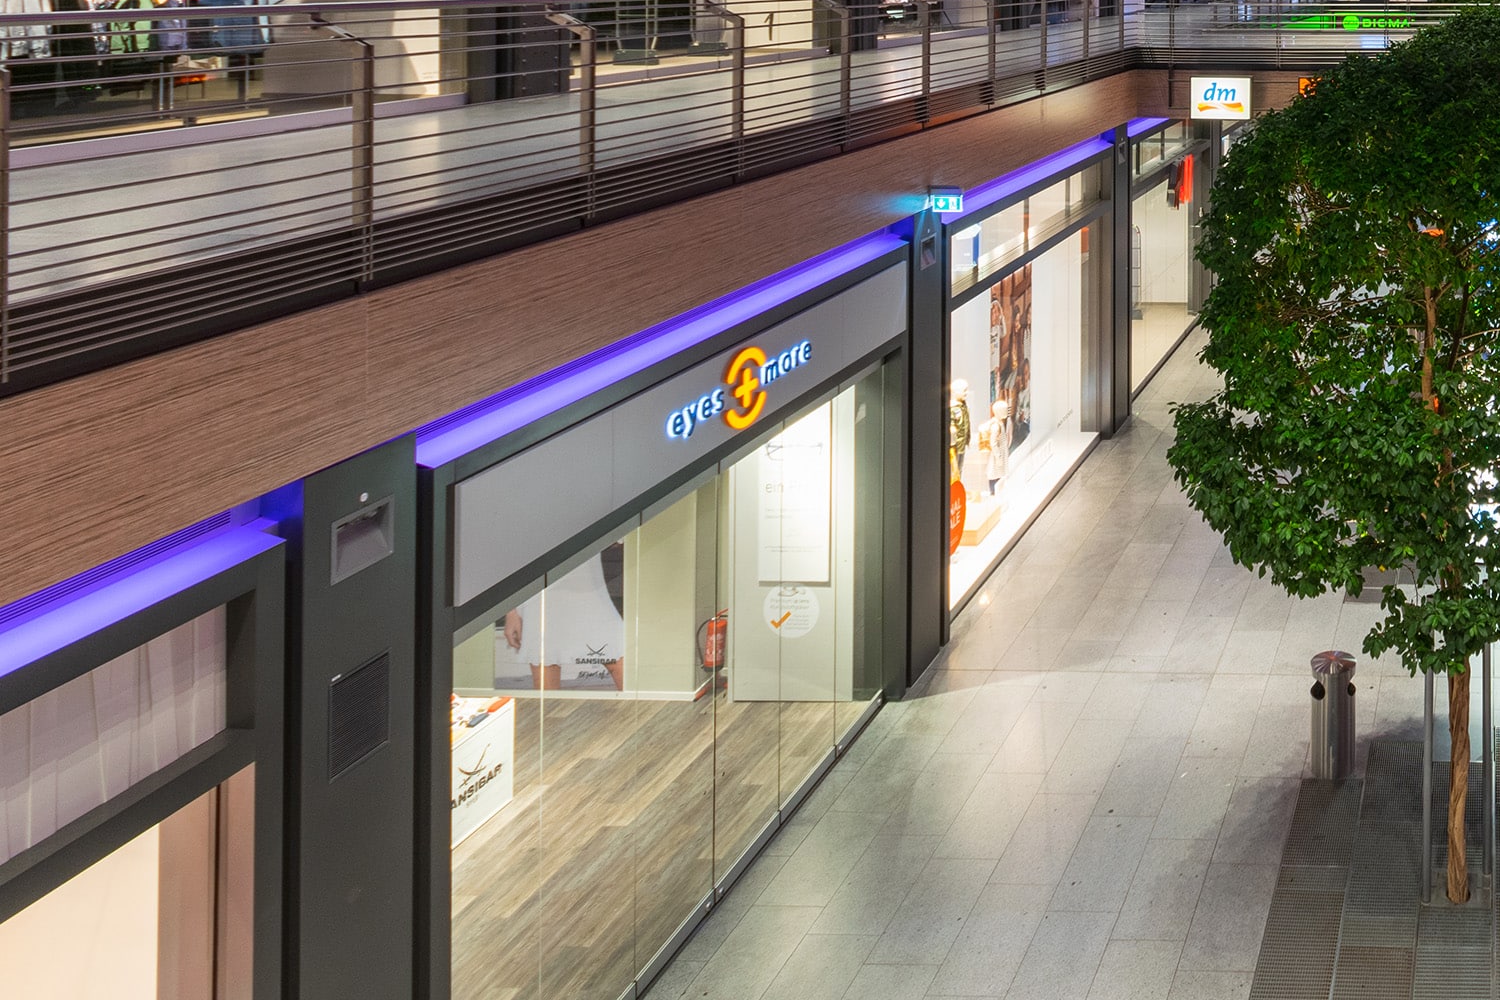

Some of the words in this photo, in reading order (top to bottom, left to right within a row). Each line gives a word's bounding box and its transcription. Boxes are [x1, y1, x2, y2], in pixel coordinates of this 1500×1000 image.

[1203, 81, 1236, 101] dm
[666, 388, 726, 440] eyes
[760, 340, 813, 386] more
[575, 657, 617, 665] SANSIBAR
[450, 762, 503, 810] ANSIBAR
